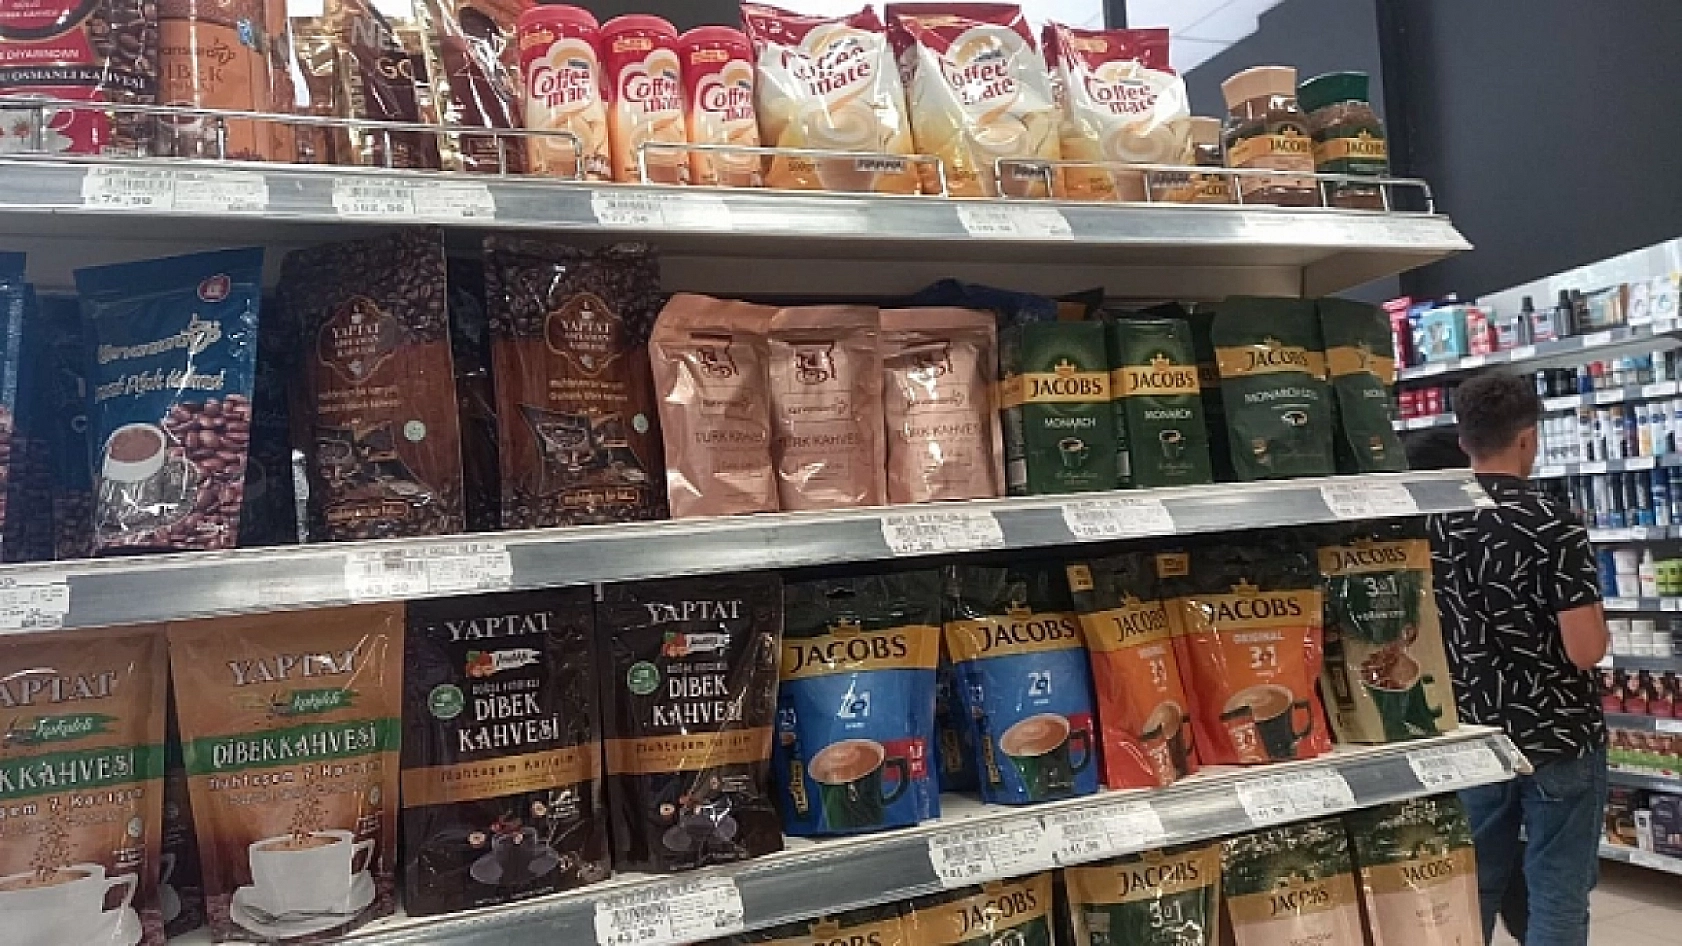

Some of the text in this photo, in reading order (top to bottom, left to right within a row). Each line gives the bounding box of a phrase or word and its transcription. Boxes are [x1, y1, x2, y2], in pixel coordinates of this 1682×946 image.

[532, 65, 590, 99] Coffee
[809, 62, 871, 95] mate
[546, 85, 590, 109] mate
[1030, 377, 1104, 397] JACOBS
[1128, 369, 1196, 390] JACOBS
[1044, 416, 1097, 429] MONARCH
[1143, 408, 1194, 420] MONARCH
[1330, 547, 1407, 573] JACOBS
[1365, 575, 1399, 597] 31
[643, 599, 743, 625] YAPTAT
[1112, 603, 1168, 642] JACOBS
[1202, 596, 1303, 625] JACOBS
[444, 610, 554, 642] YAPTAT
[978, 617, 1075, 652] JACOBS
[227, 649, 361, 687] YAPTAT
[788, 635, 907, 674] JACOBS
[1249, 646, 1278, 669] 31
[1027, 669, 1053, 697] 21
[473, 691, 541, 722] DİBEK
[458, 712, 560, 753] KAHVESİ
[1116, 860, 1199, 897] JACOBS
[1401, 856, 1454, 885] JACOBS
[956, 887, 1037, 937] JACOBS
[1149, 900, 1184, 928] 31
[1270, 888, 1329, 916] JACOBS
